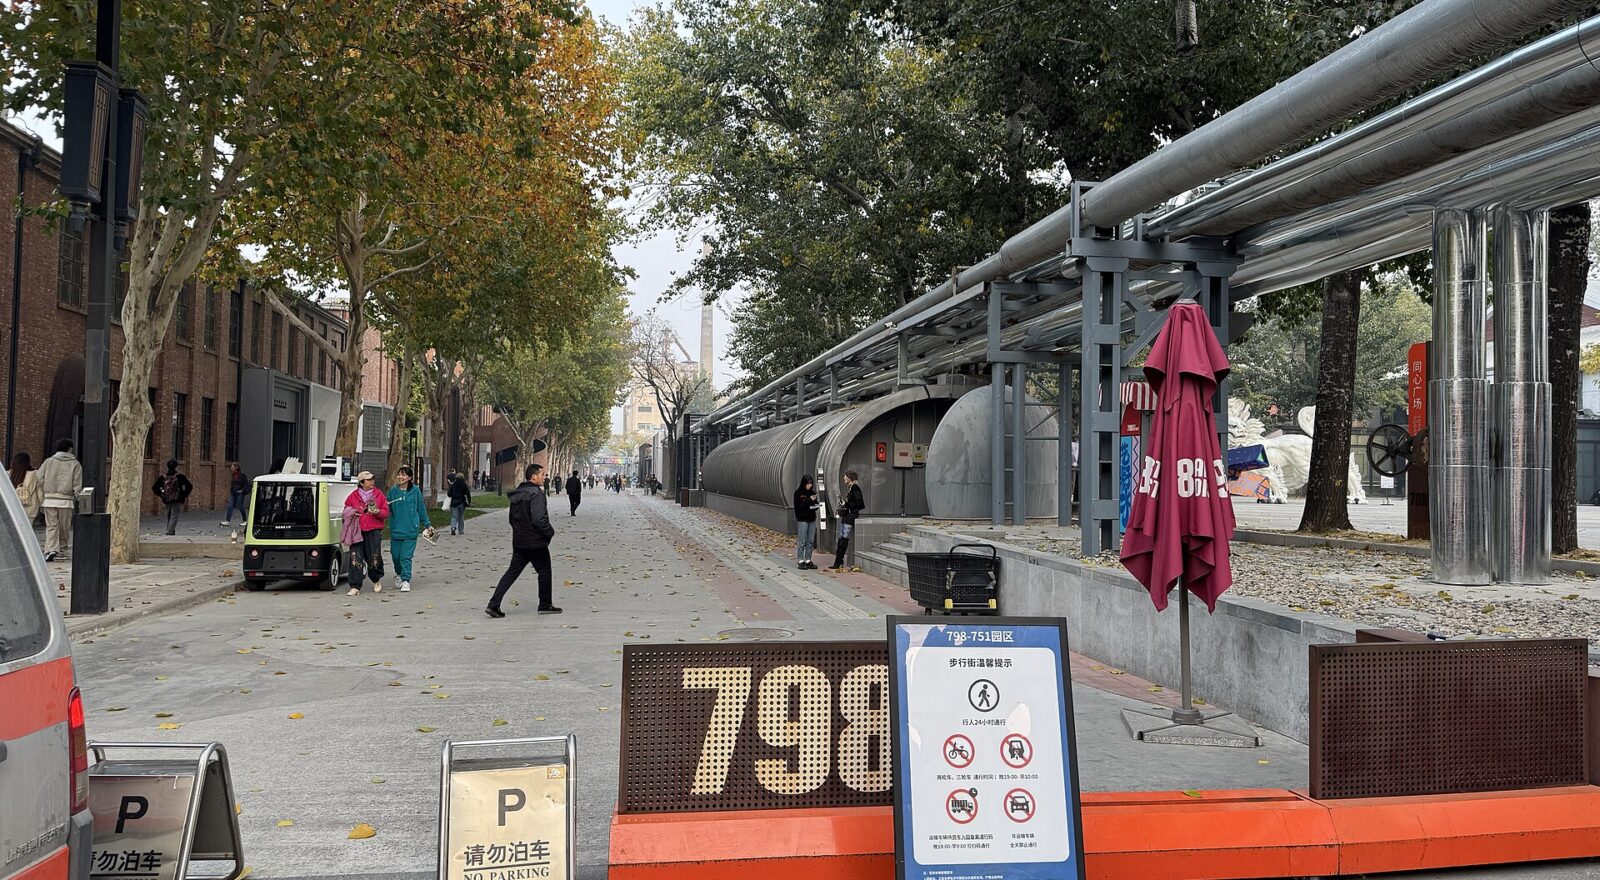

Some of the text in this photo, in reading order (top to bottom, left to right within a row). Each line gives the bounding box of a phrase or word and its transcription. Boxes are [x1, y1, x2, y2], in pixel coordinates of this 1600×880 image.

[1412, 361, 1422, 410] 同心广场
[946, 630, 1014, 642] 798-751园区
[949, 658, 1012, 668] 步行街温馨提示
[681, 664, 893, 796] 798
[115, 796, 149, 833] P
[498, 788, 527, 826] P
[464, 840, 550, 866] 请勿泊车
[490, 867, 549, 880] PARKING
